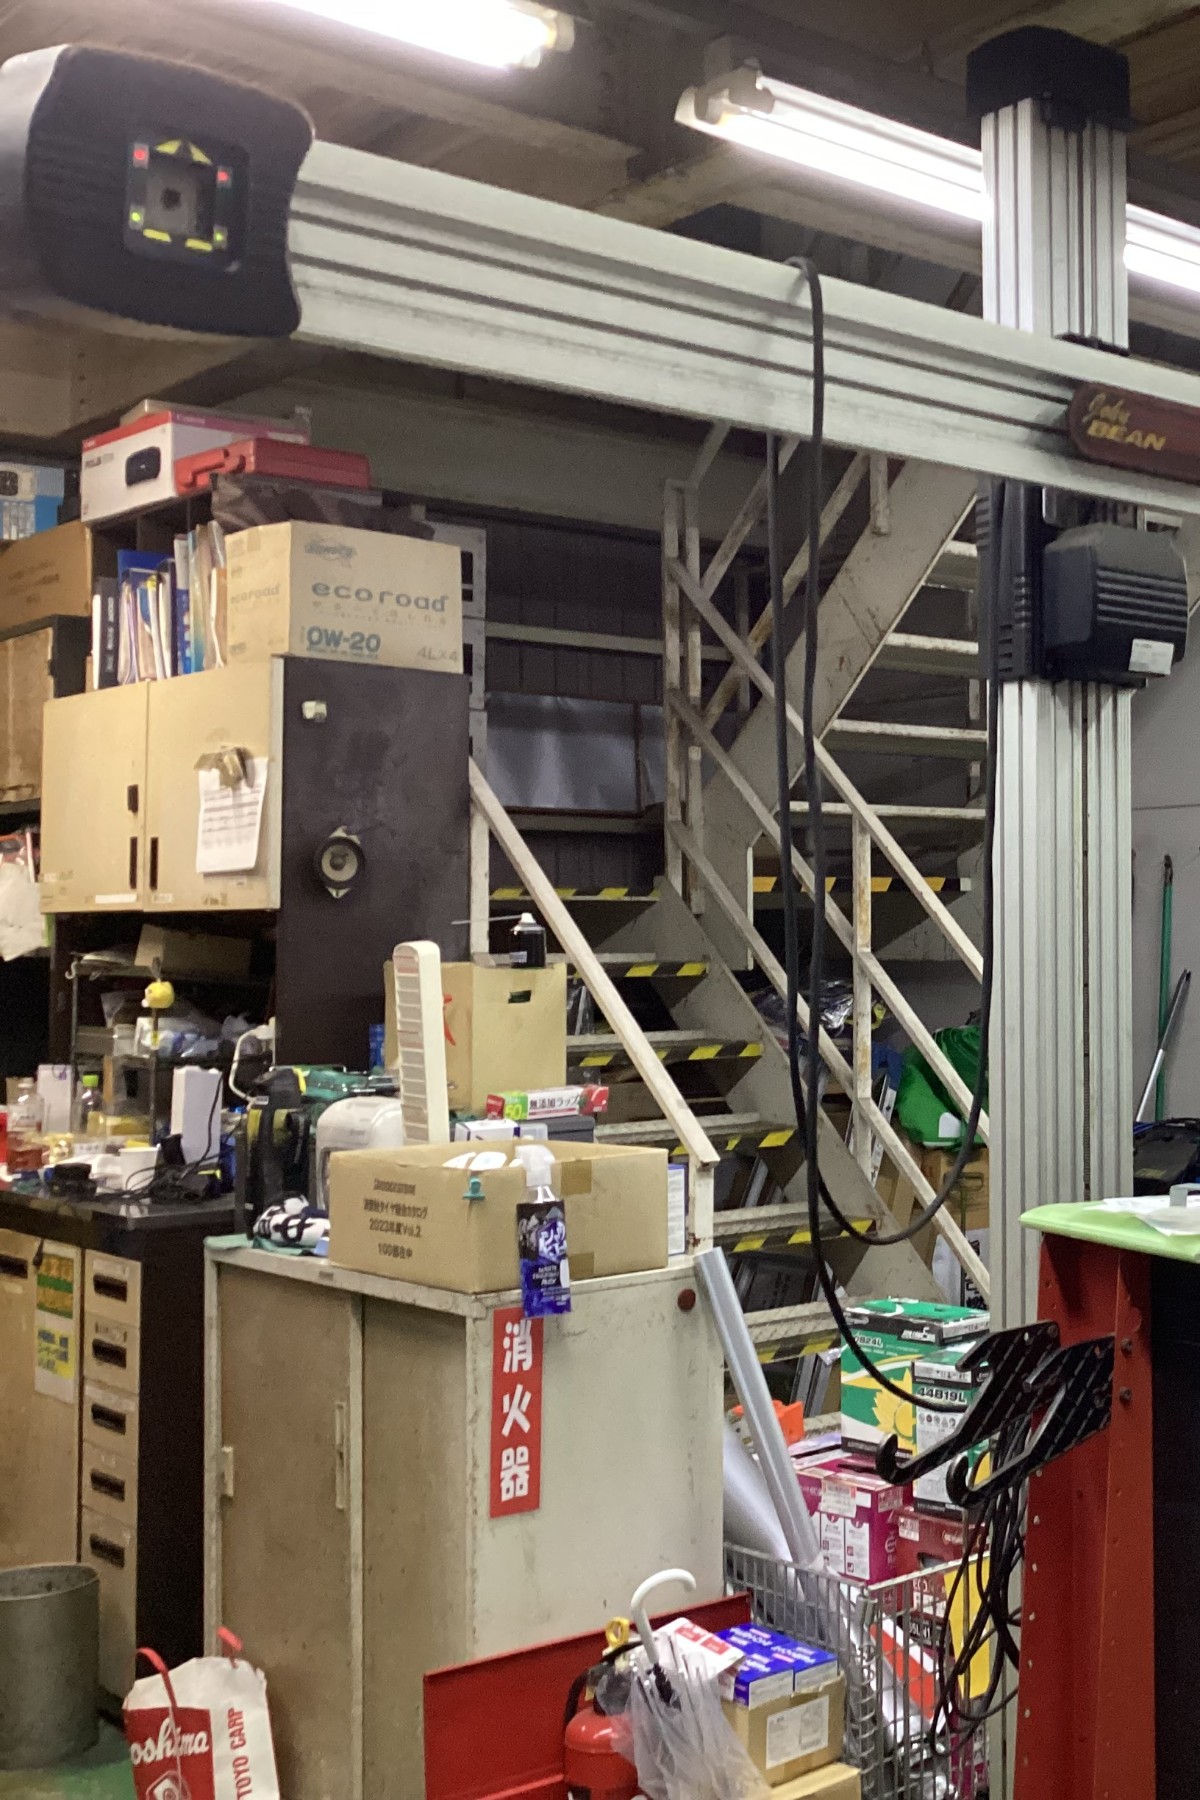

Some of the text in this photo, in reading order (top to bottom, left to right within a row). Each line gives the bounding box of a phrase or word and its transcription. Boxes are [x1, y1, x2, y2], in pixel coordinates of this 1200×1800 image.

[311, 580, 450, 613] ecoroad
[501, 1319, 534, 1502] 消火器
[917, 1386, 968, 1405] 44B19L
[227, 1707, 247, 1750] CARP
